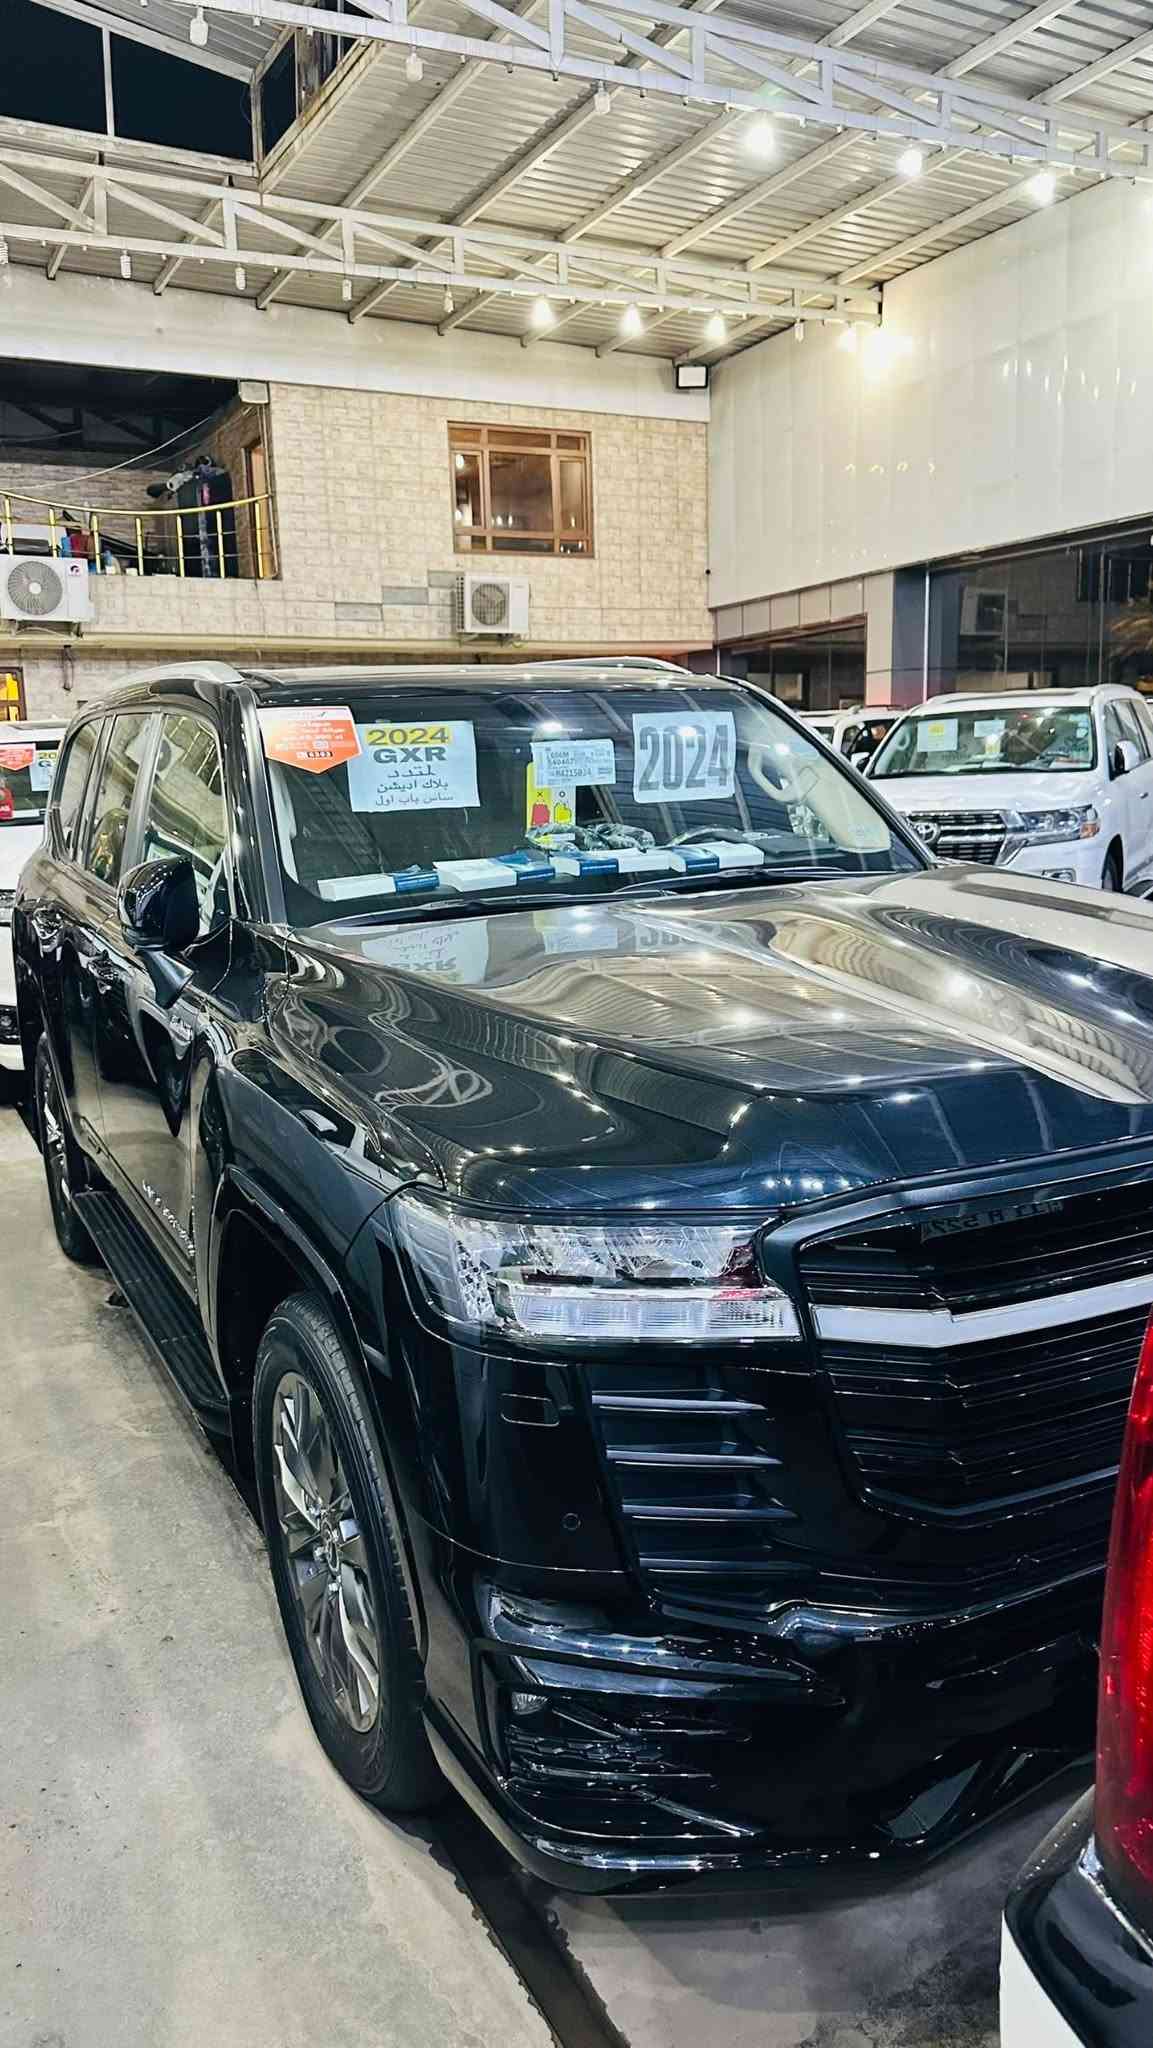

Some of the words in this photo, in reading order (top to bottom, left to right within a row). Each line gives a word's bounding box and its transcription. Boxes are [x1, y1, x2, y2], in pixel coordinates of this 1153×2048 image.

[367, 727, 449, 745] 2024
[373, 746, 447, 764] GXR
[639, 725, 728, 791] 2024
